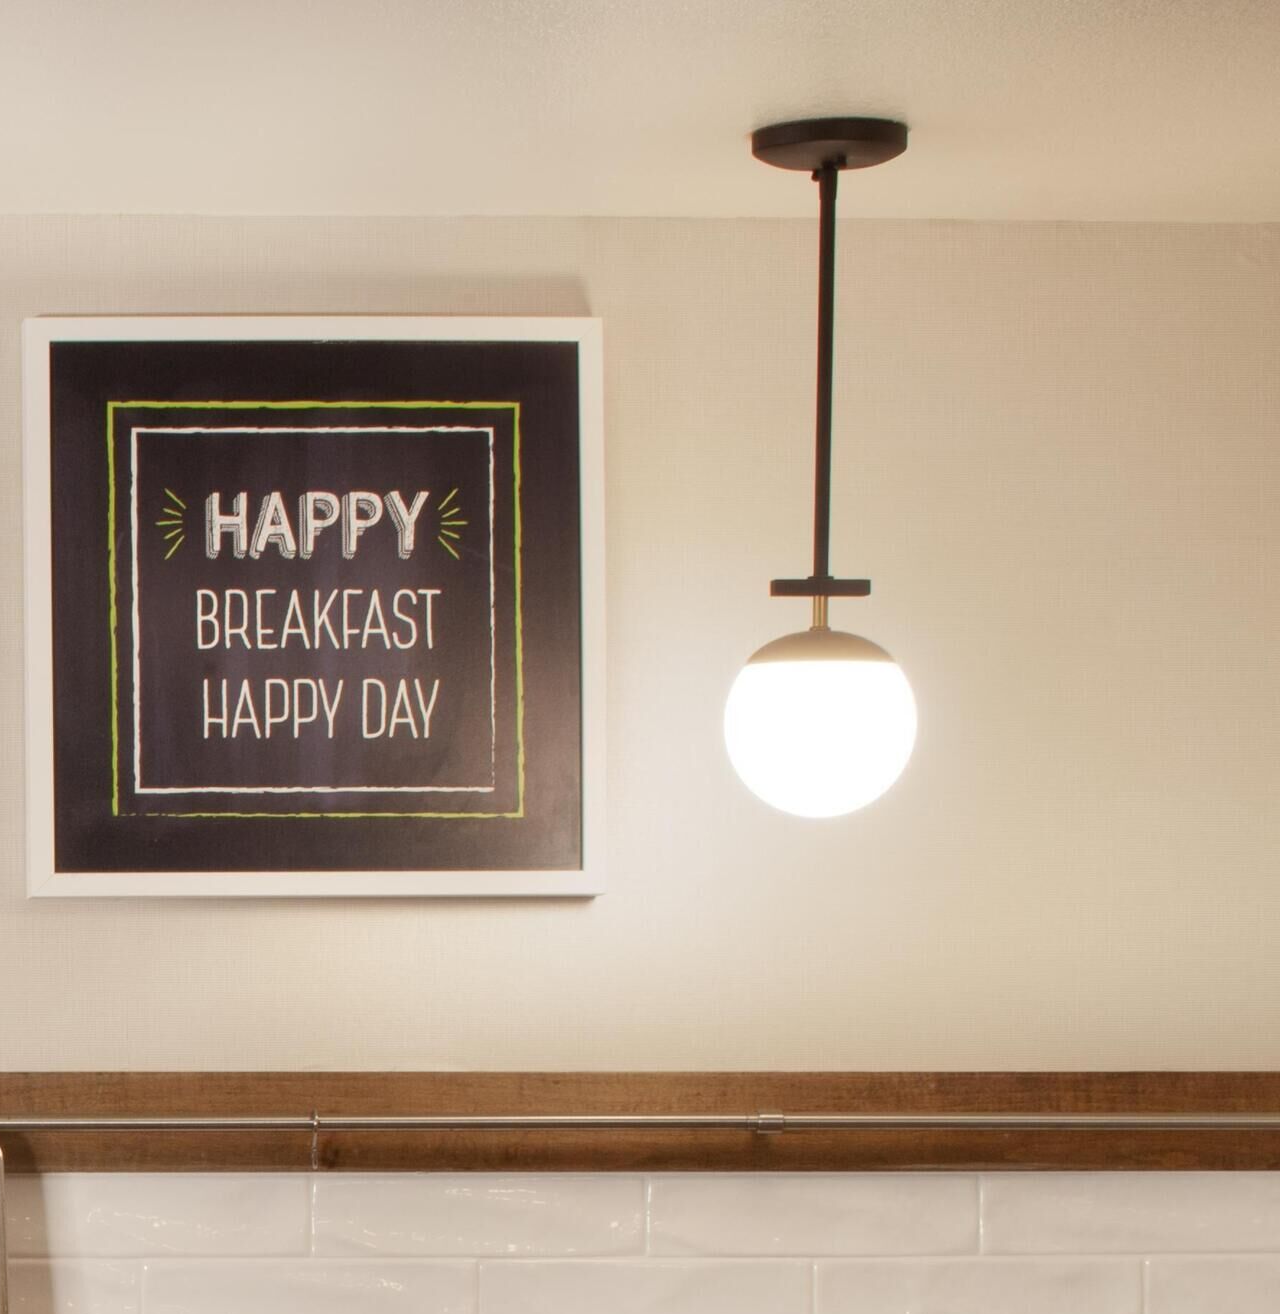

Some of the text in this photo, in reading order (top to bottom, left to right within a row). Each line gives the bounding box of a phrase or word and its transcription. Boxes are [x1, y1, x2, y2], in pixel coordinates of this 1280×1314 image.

[205, 490, 429, 560] HAPPY
[196, 588, 441, 650] BREAKFAST
[203, 678, 440, 739] HAPPY DAY
